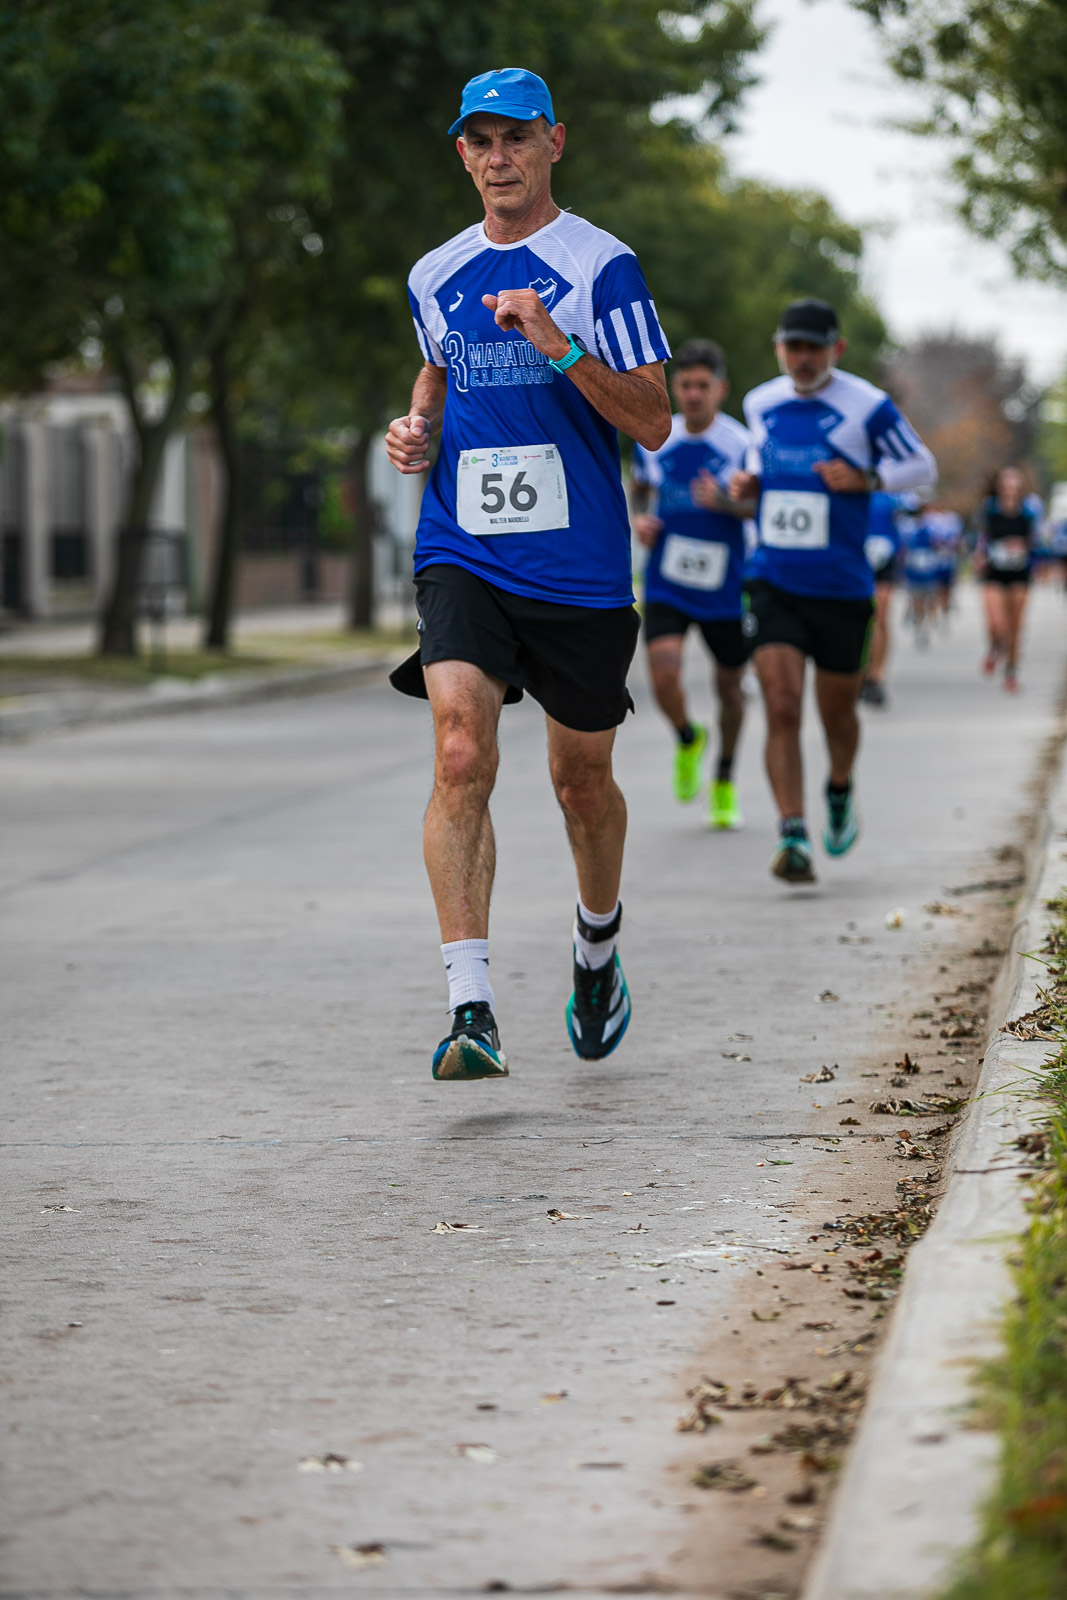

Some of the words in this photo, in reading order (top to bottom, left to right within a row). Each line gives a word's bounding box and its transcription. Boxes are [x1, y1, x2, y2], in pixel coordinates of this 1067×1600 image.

[444, 330, 470, 393] 3
[480, 470, 538, 514] 56
[771, 507, 812, 534] 40
